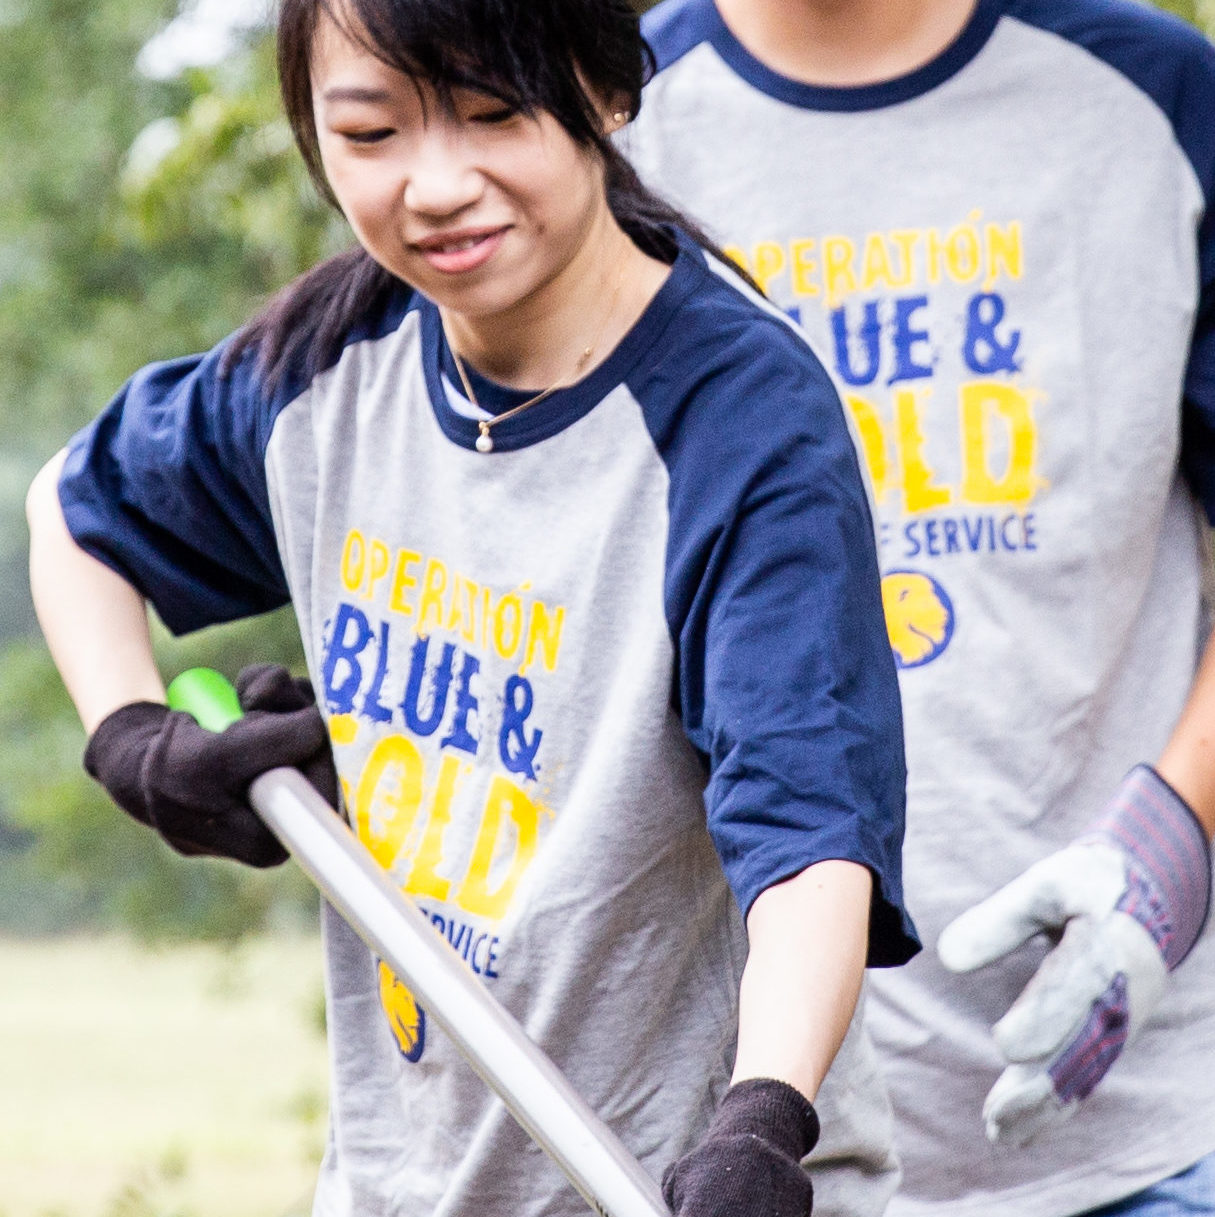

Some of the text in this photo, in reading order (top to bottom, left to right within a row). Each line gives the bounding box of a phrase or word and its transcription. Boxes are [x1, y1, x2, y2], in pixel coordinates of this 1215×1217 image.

[786, 292, 1022, 385] UE &
[845, 379, 1038, 515] LD
[904, 514, 1038, 558] SERVICE
[340, 529, 565, 672] OPERATION
[321, 602, 543, 782] BLUE &
[420, 906, 500, 979] VICE
